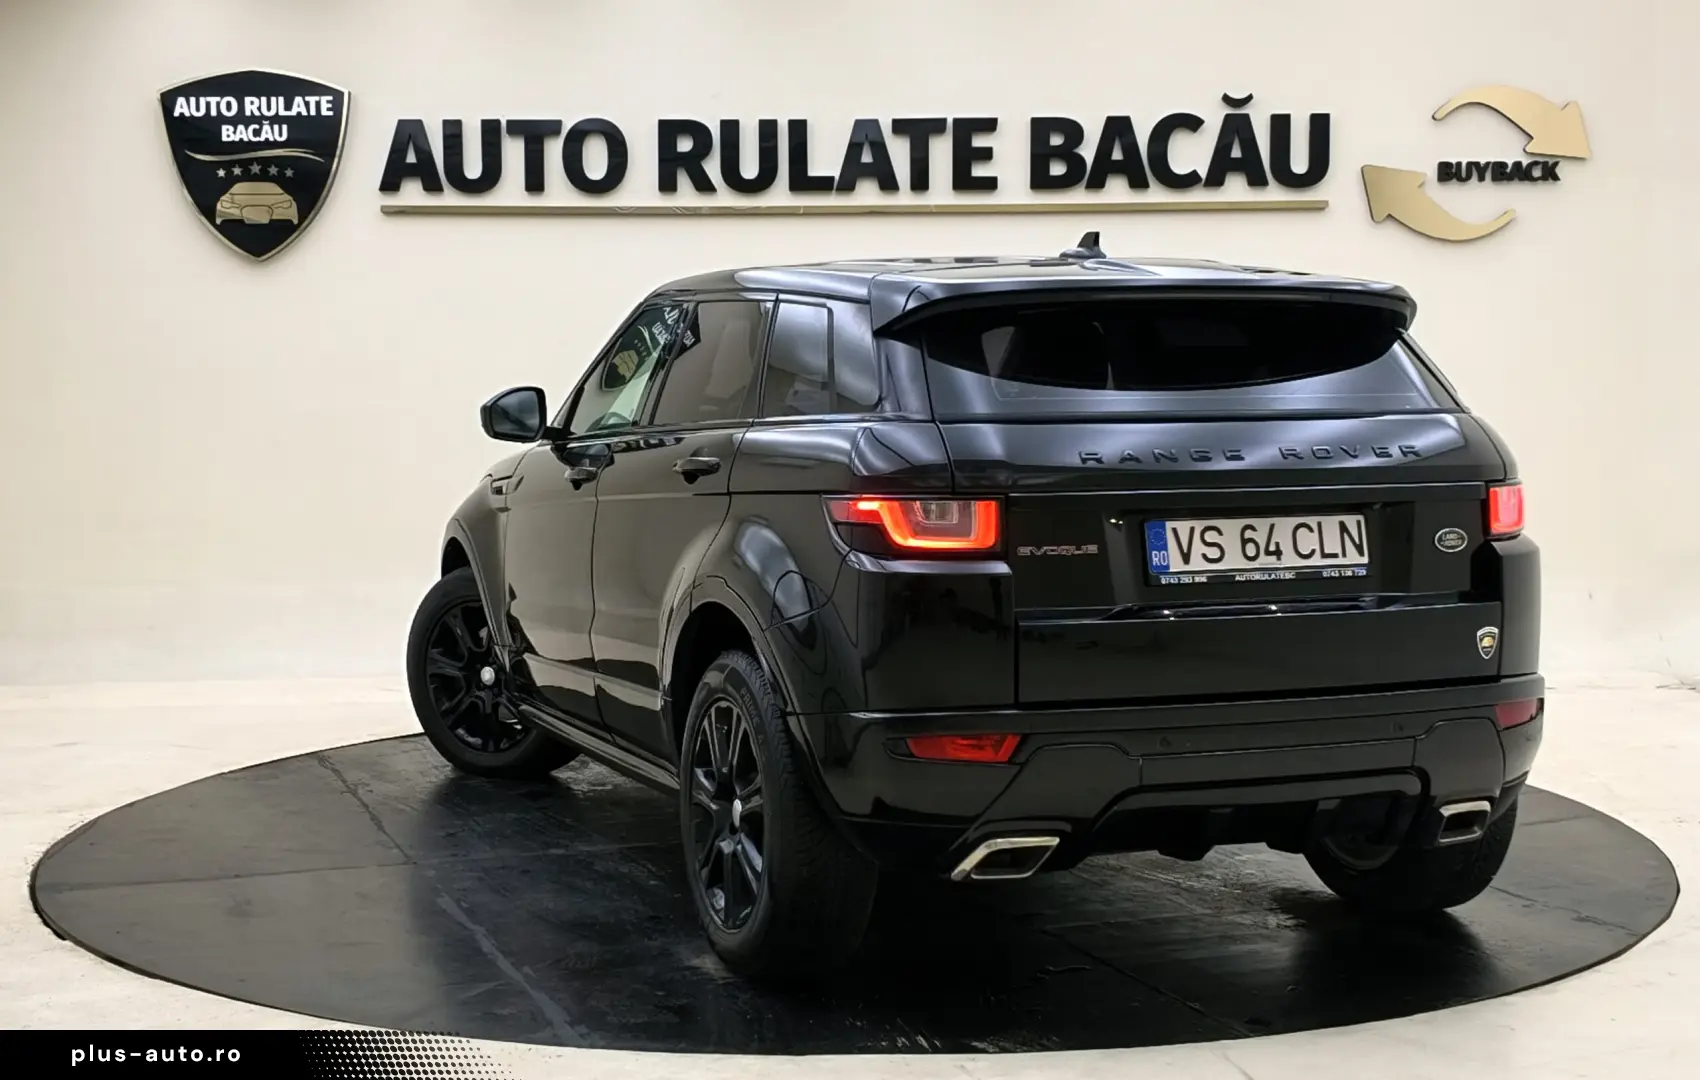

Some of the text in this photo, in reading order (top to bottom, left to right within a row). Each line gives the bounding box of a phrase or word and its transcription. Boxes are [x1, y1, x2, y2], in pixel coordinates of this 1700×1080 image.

[173, 95, 334, 117] AUTO RULATE
[220, 120, 288, 142] BACĂU
[378, 92, 1331, 195] AUTO RULATE BACĂU
[1436, 159, 1562, 183] BUYBACK
[1078, 444, 1423, 465] RANGE ROVER
[1016, 544, 1098, 556] EVOQUE
[1171, 519, 1365, 566] VS 64 CLN
[1151, 551, 1168, 566] RO
